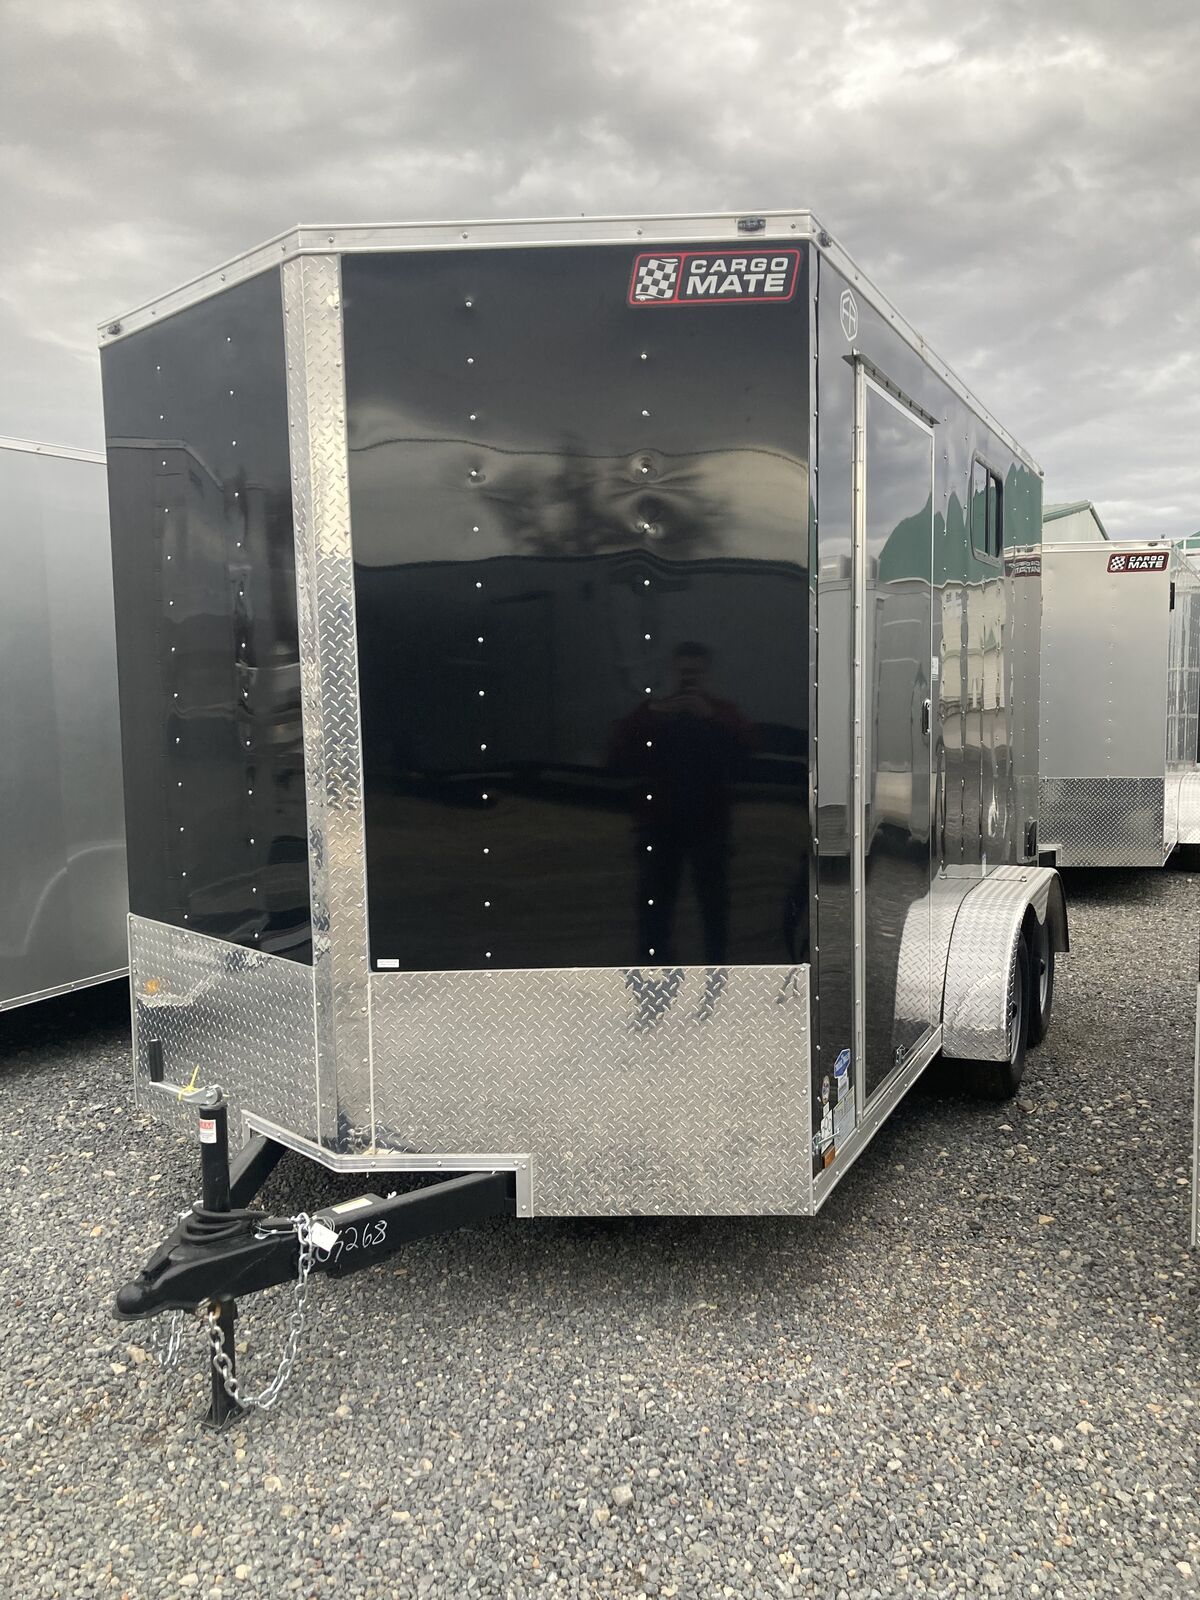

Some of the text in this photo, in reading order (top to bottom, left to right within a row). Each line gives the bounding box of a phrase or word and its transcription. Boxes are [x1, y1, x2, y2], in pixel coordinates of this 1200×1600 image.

[690, 257, 789, 274] CARGO
[686, 273, 786, 295] MATE
[1128, 561, 1163, 569] MATE
